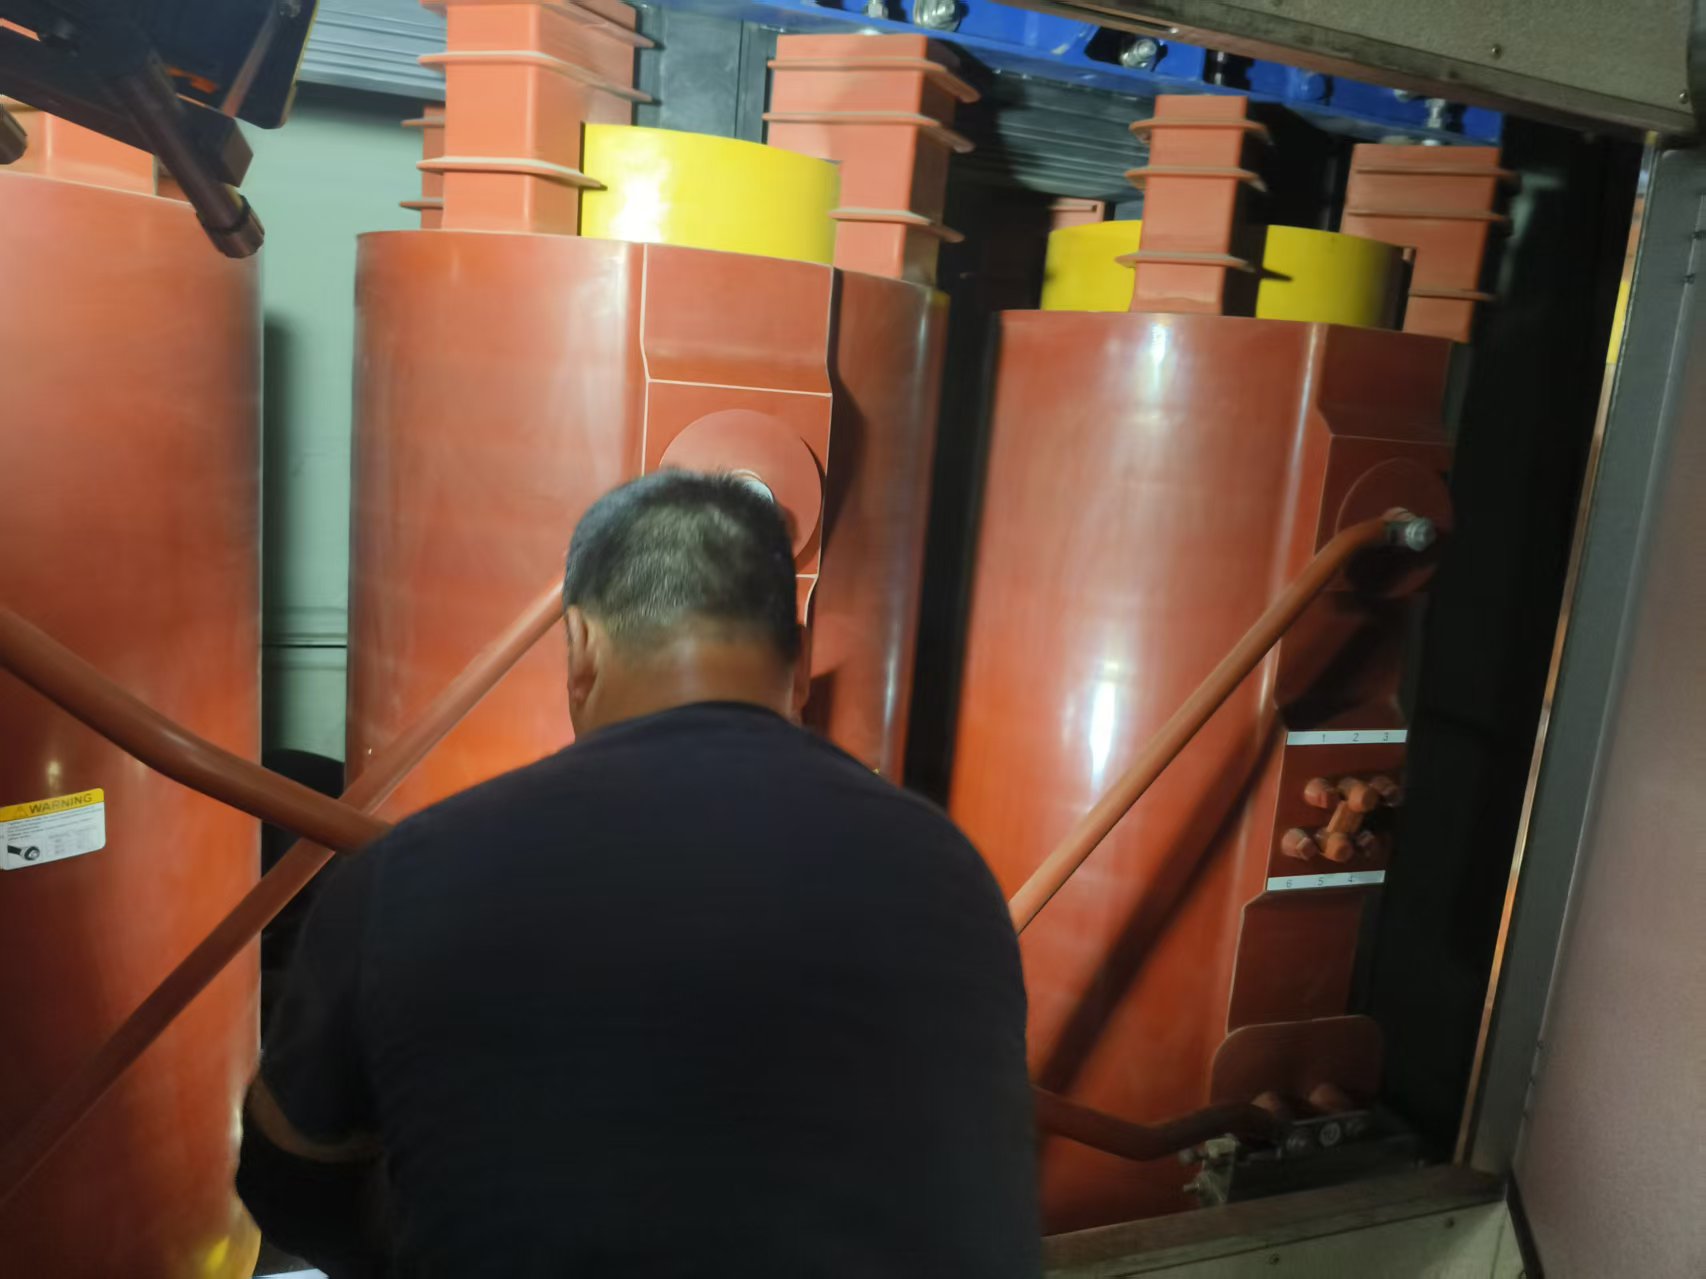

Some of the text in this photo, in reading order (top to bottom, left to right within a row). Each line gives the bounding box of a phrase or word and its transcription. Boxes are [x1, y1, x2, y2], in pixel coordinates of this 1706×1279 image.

[1352, 732, 1359, 742] 2
[1383, 732, 1389, 742] 3
[29, 793, 93, 814] WARNING
[1286, 879, 1292, 888] 6
[1317, 877, 1324, 886] 5
